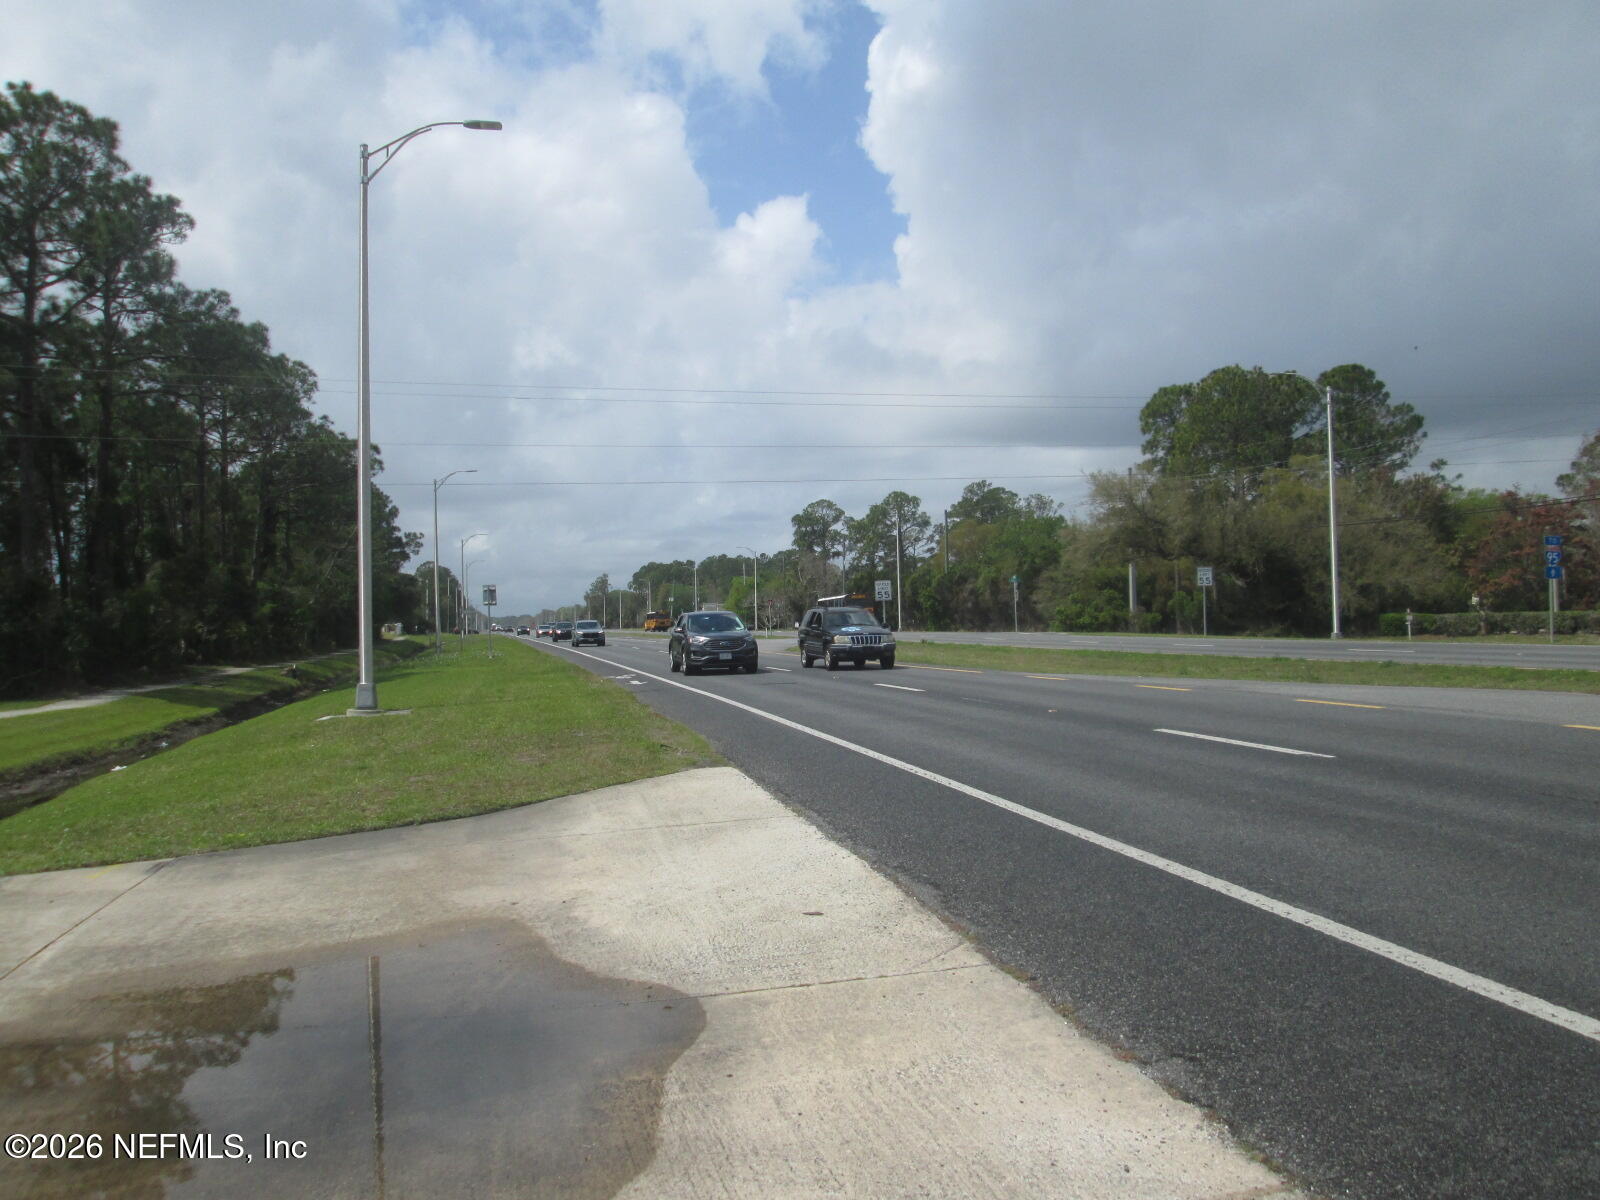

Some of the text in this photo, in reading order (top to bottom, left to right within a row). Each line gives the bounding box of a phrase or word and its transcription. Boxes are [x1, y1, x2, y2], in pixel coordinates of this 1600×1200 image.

[1546, 552, 1559, 565] 95
[1199, 576, 1211, 585] 55
[877, 591, 890, 599] 55
